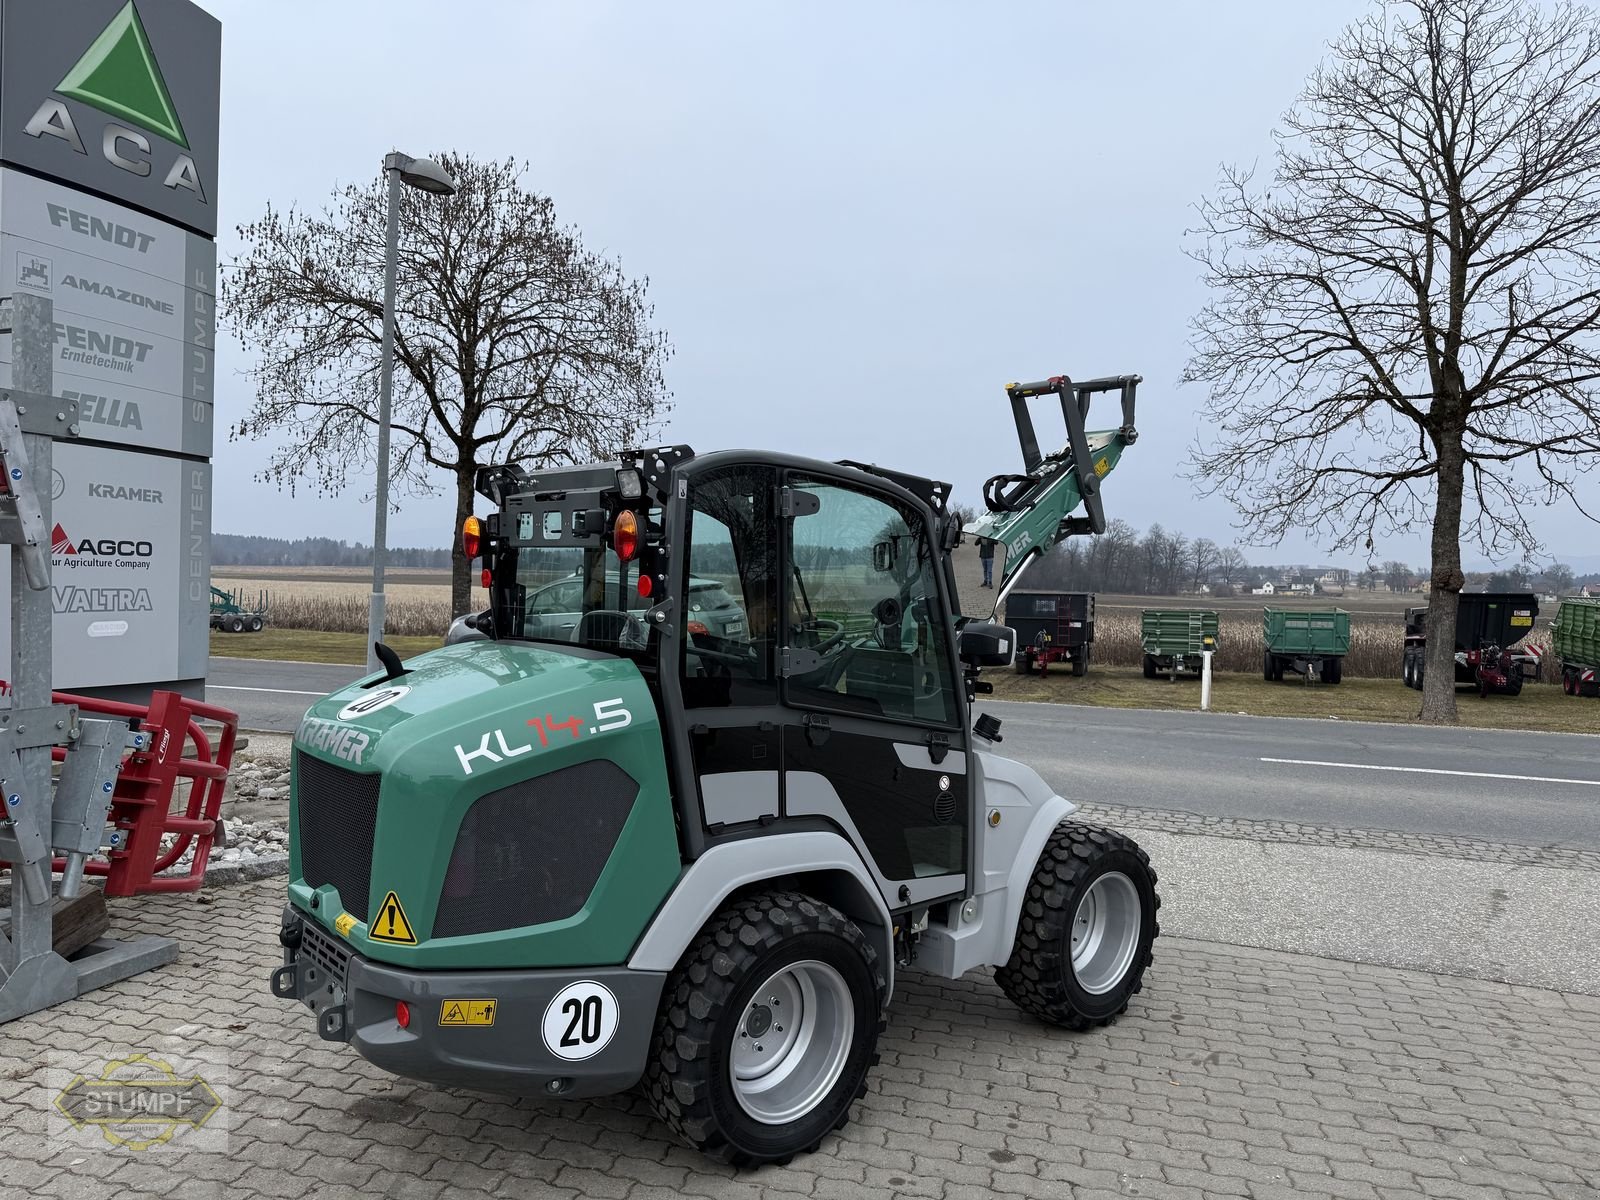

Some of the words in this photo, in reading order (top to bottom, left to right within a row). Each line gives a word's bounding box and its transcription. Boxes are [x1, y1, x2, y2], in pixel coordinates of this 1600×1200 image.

[22, 97, 207, 204] ACA
[46, 202, 156, 253] FENDT
[60, 274, 174, 315] AMAZONE
[60, 347, 134, 374] Erntetechnik
[192, 268, 208, 424] STUMPF
[88, 482, 163, 504] KRAMER
[77, 539, 153, 557] AGCO
[189, 469, 204, 601] CENTER
[1005, 530, 1033, 564] MER
[64, 558, 113, 568] Agriculture
[115, 559, 151, 570] Company
[52, 586, 153, 613] VALTRA
[347, 690, 401, 713] 20
[294, 718, 370, 766] KRAMER
[559, 995, 602, 1048] 20
